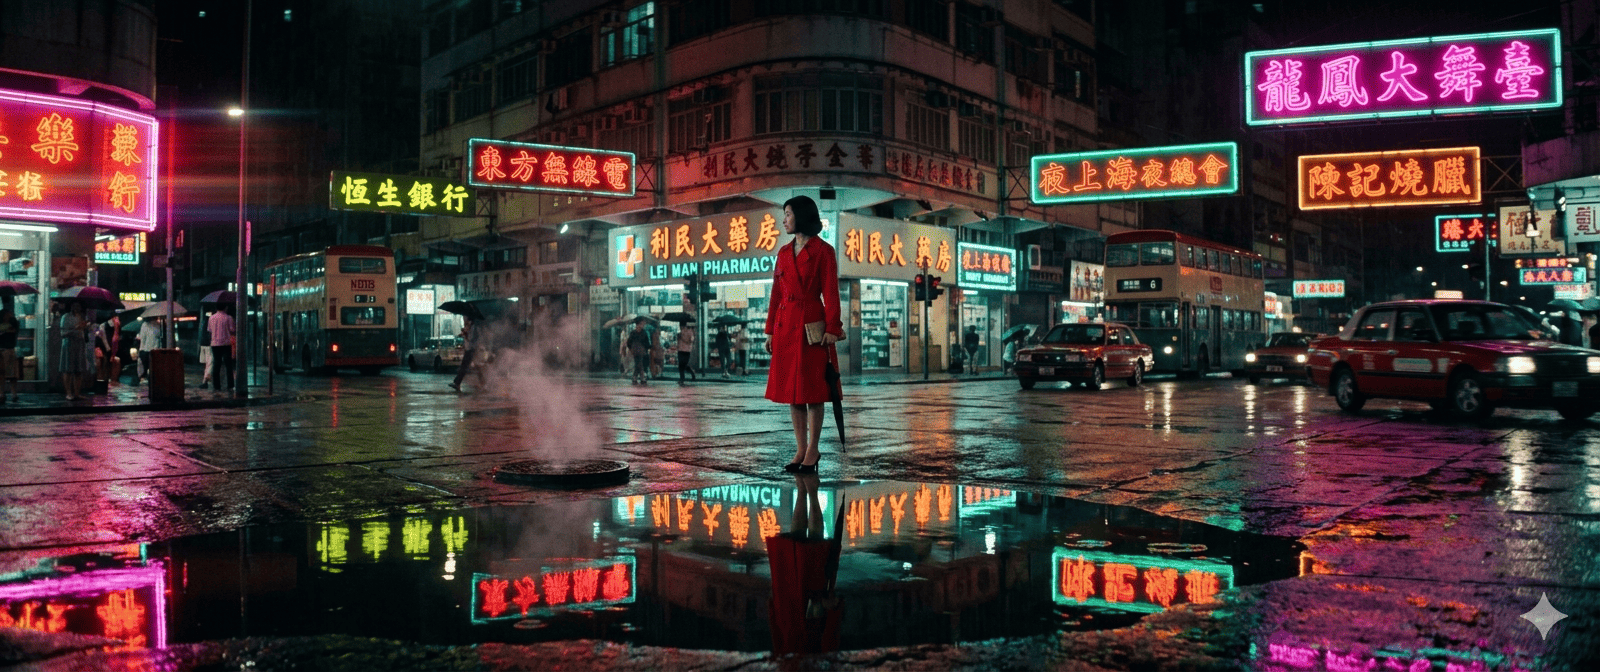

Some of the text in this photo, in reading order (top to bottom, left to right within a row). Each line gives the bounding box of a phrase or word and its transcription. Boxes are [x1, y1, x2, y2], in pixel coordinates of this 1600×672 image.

[1257, 40, 1544, 112] 龍鳳大舞臺
[477, 145, 628, 190] 東方無線電
[1039, 154, 1228, 195] 夜上海夜總會
[1308, 156, 1471, 200] 陳記燒臘
[340, 175, 469, 213] 恆生銀行
[650, 213, 780, 260] 利民大藥房
[650, 264, 667, 279] LEI
[671, 262, 699, 277] MAN
[1150, 280, 1157, 289] 6
